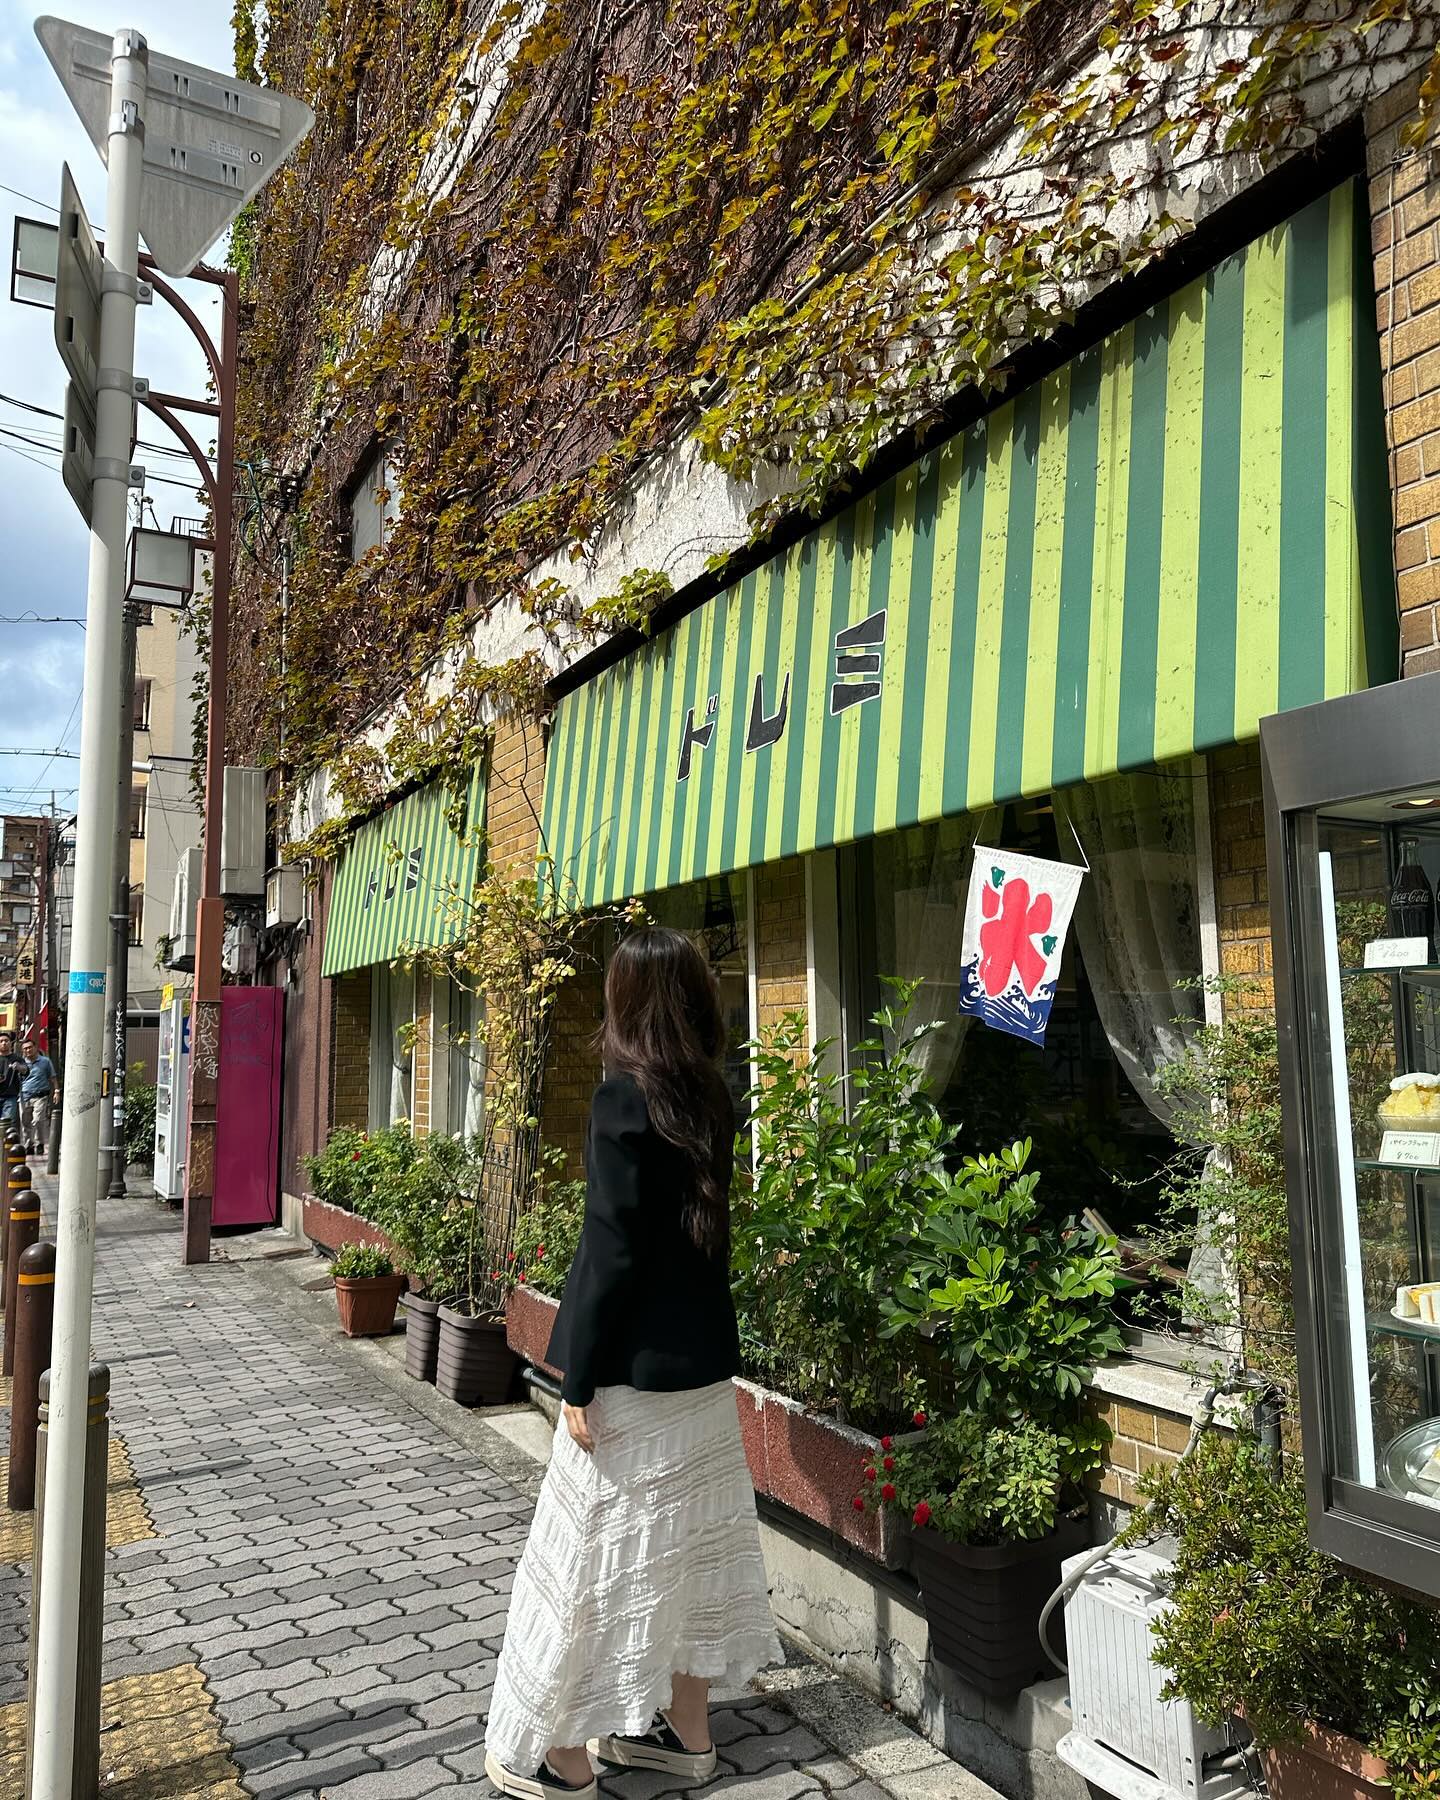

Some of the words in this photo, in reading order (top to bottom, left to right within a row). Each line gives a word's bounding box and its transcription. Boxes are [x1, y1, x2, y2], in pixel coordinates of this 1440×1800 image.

[676, 608, 887, 782] ドレミ
[19, 955, 34, 980] 香港
[979, 878, 1053, 998] 氷
